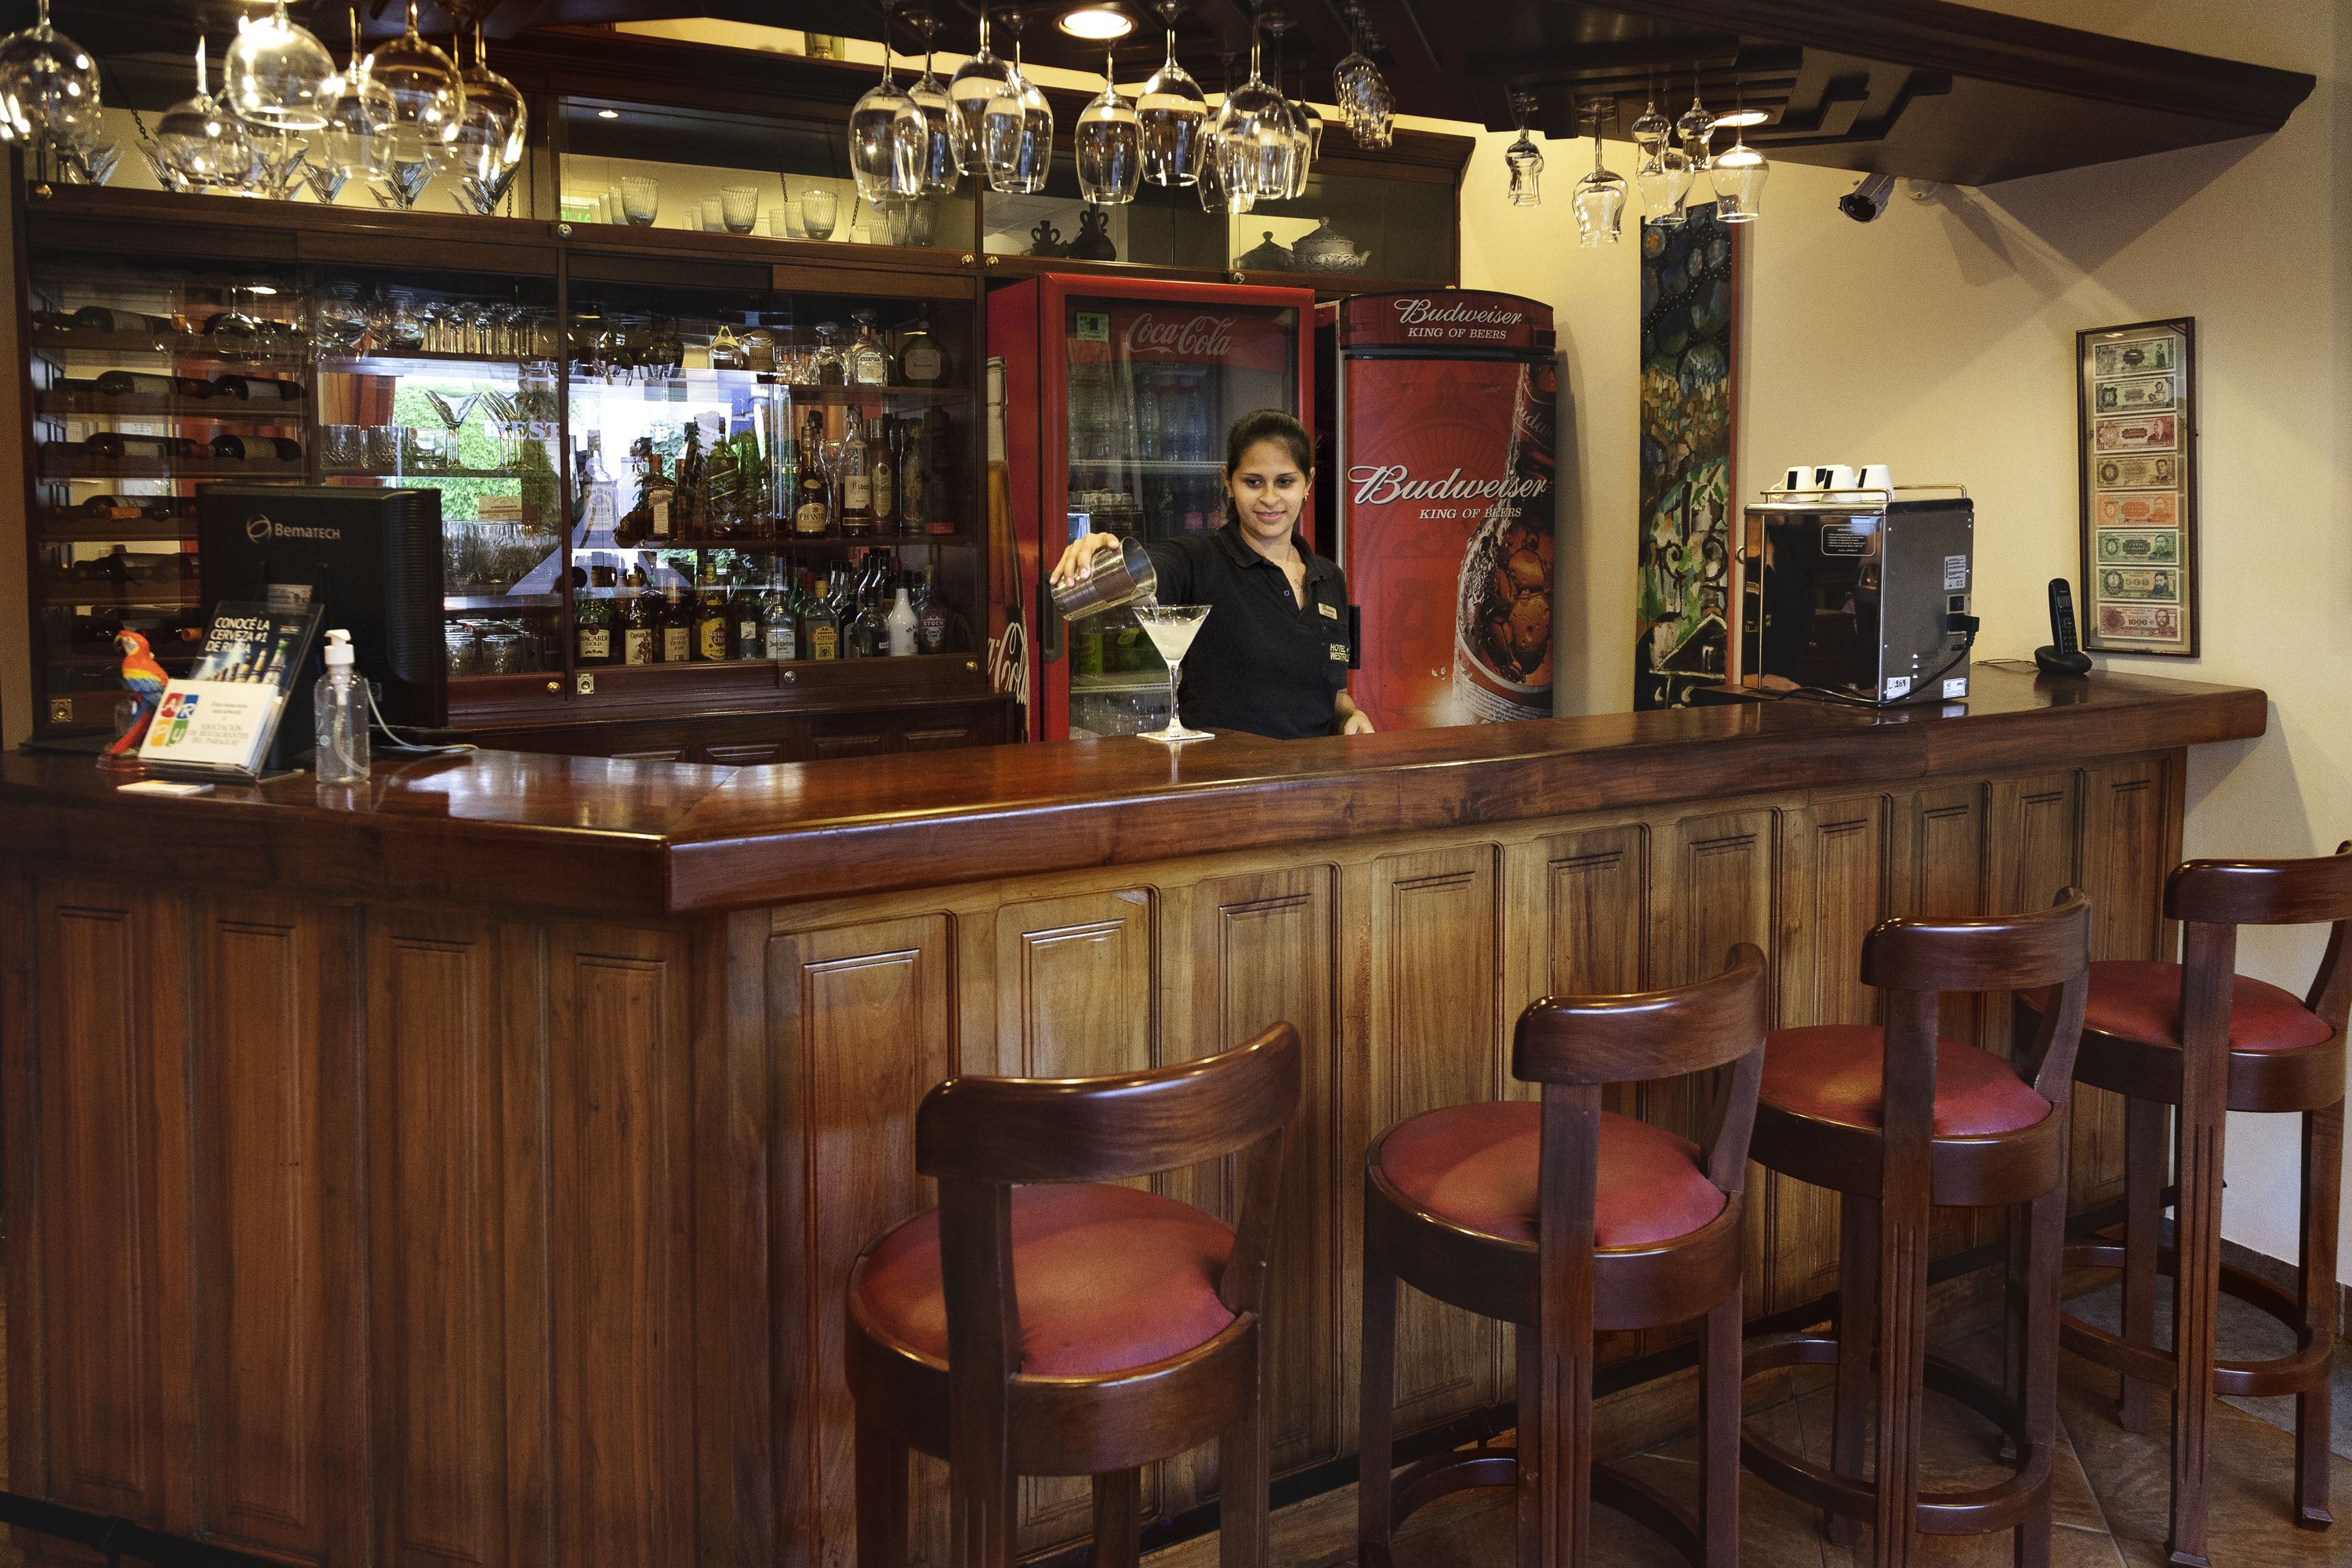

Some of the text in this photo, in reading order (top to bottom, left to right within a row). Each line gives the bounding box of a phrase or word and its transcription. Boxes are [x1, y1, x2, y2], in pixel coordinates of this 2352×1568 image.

[1394, 299, 1523, 325] Budweiser
[1126, 313, 1237, 356] Coca-Cola
[1407, 327, 1507, 339] KING OF BEERS
[1348, 464, 1547, 506] Budweiser
[1418, 507, 1522, 520] KING OF BEERS
[257, 619, 270, 631] LA
[210, 629, 268, 643] CERVEZA #1
[205, 641, 251, 654] DE RUA
[1330, 643, 1346, 653] HOTEL
[1330, 651, 1350, 662] WESTFAL
